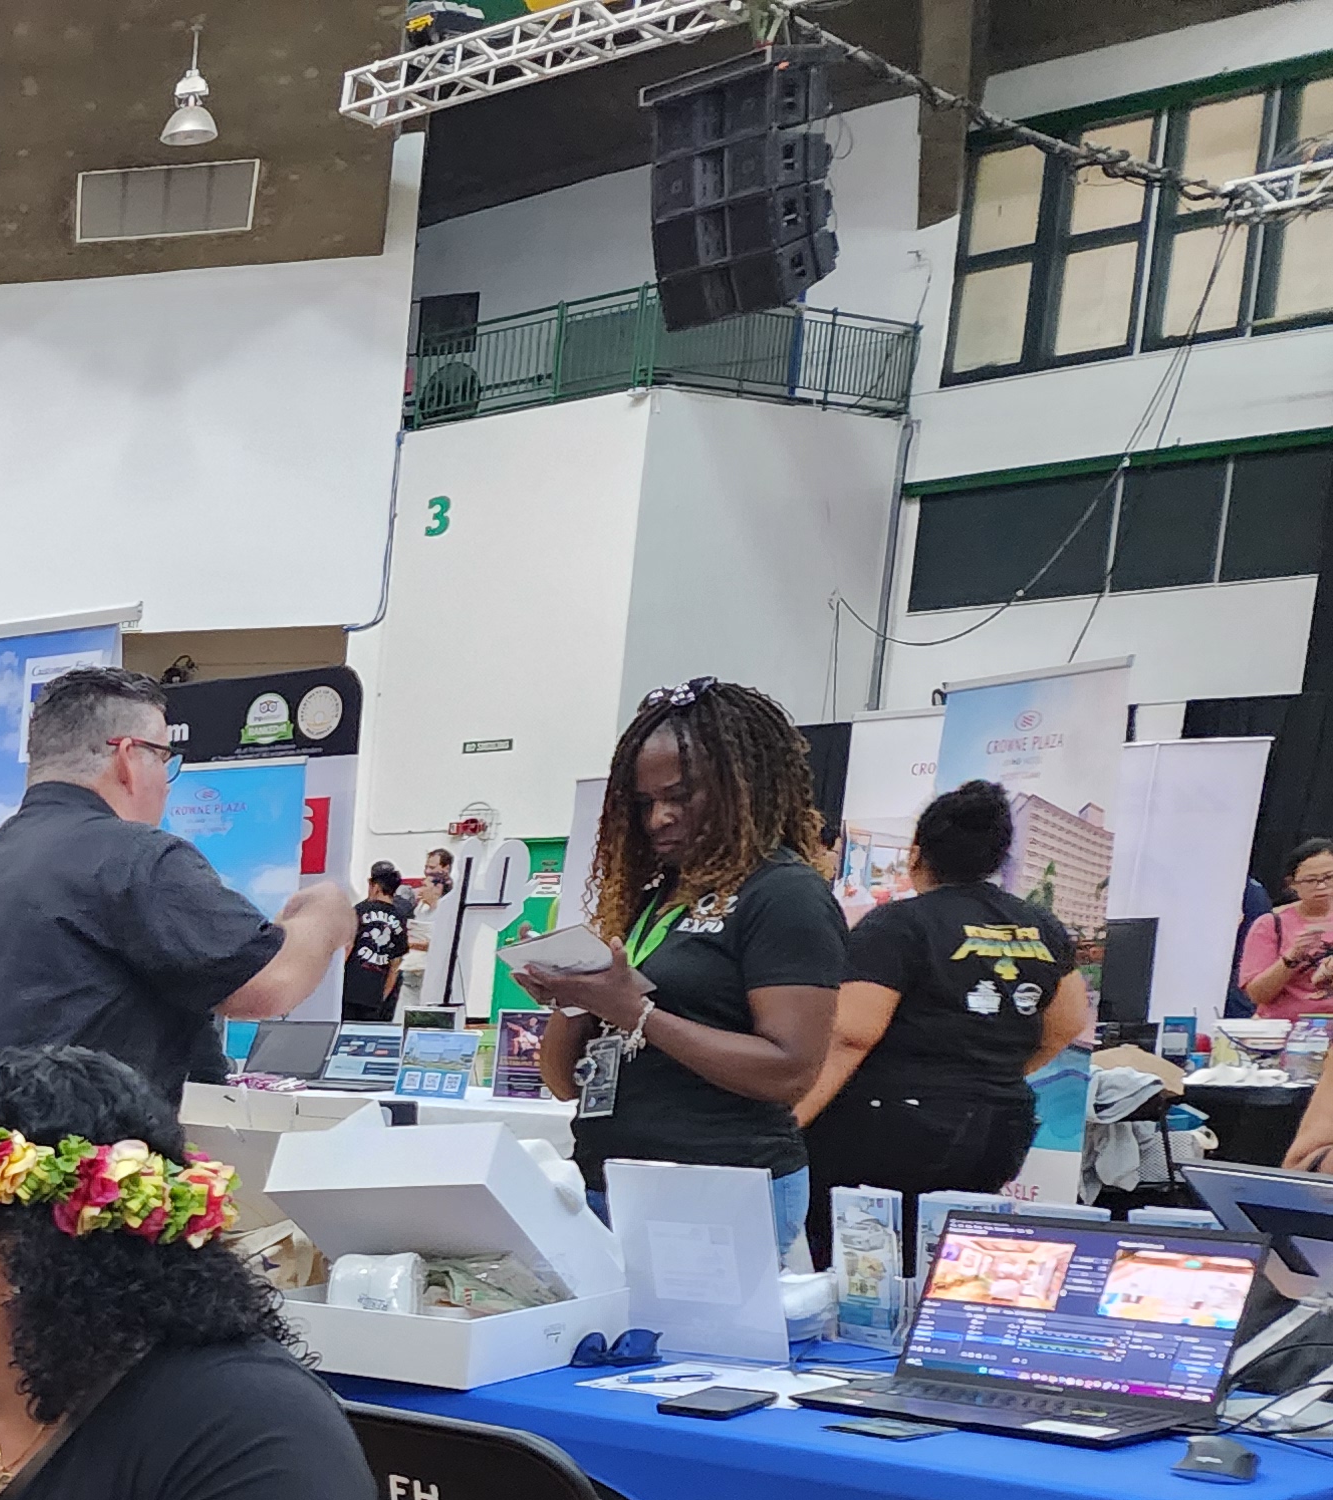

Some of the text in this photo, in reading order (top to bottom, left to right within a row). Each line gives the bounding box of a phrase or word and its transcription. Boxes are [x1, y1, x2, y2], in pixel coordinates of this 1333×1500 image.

[424, 496, 451, 537] 3
[986, 733, 1064, 755] CROWNE PLAZA
[214, 802, 248, 814] PLAZA
